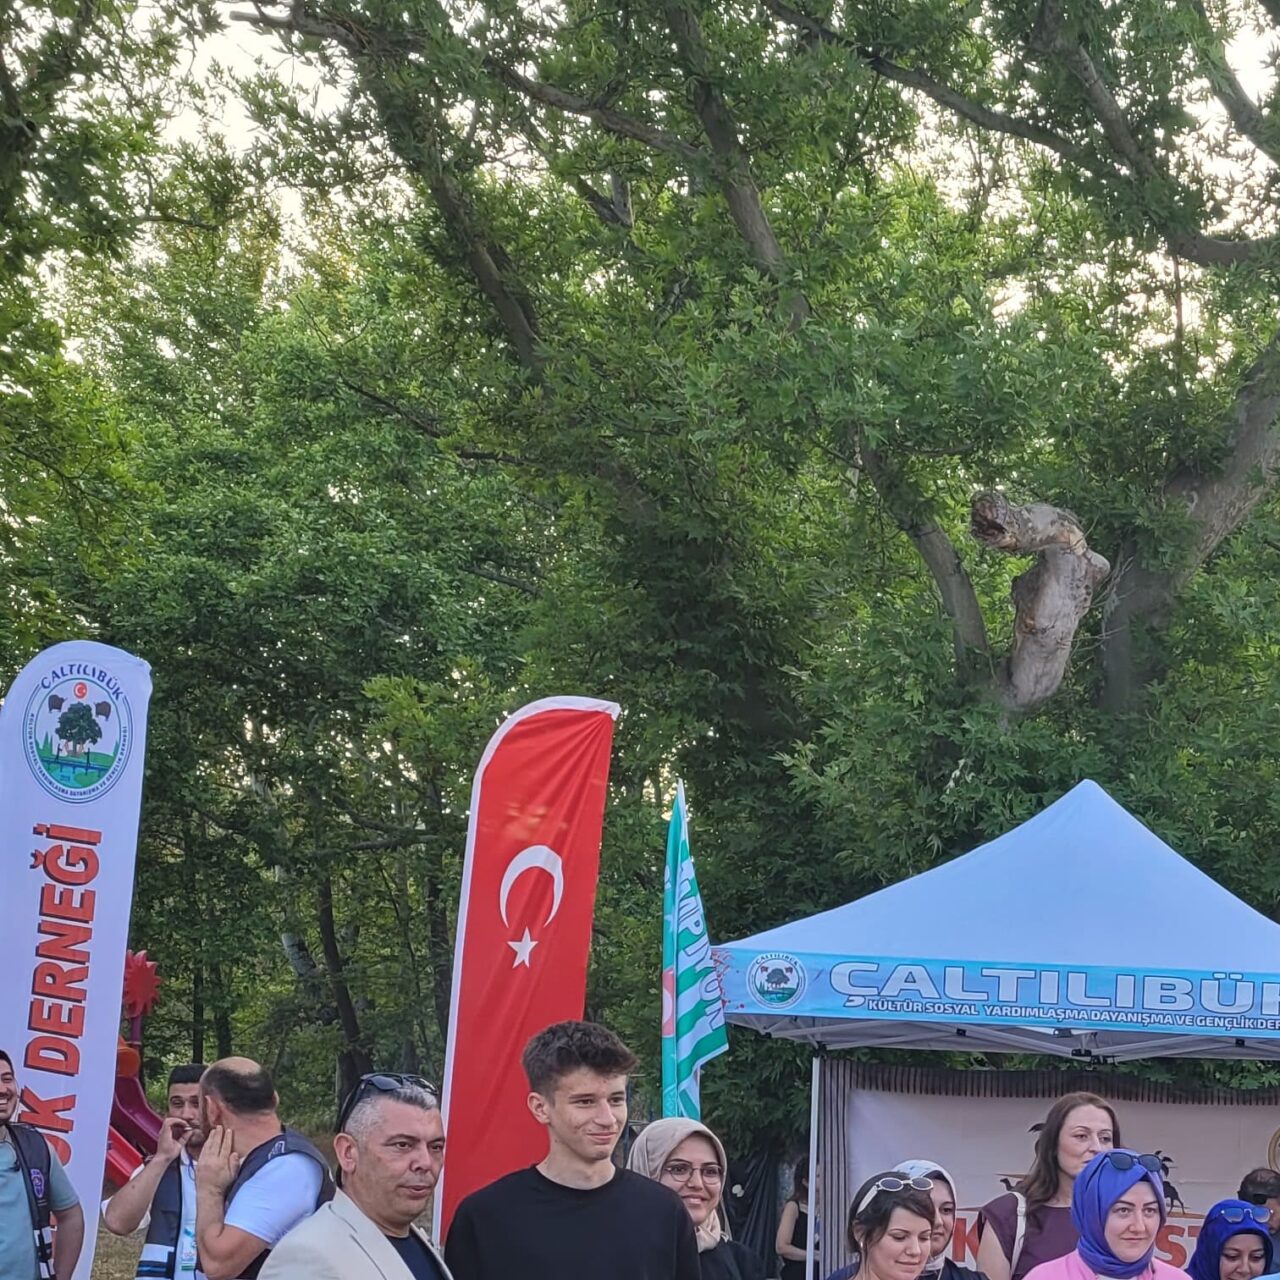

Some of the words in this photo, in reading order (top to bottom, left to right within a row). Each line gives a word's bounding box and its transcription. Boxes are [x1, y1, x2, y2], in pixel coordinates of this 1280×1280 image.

[24, 822, 102, 1077] DERNEĞİ
[867, 998, 924, 1013] KÜLTÜR
[925, 1002, 980, 1016] SOSYAL
[984, 1003, 1090, 1022] YARDIMLAŞMA
[1091, 1009, 1175, 1026] DAYANIŞMA
[1175, 1014, 1194, 1027] VE
[1195, 1014, 1255, 1031] GENÇLİK
